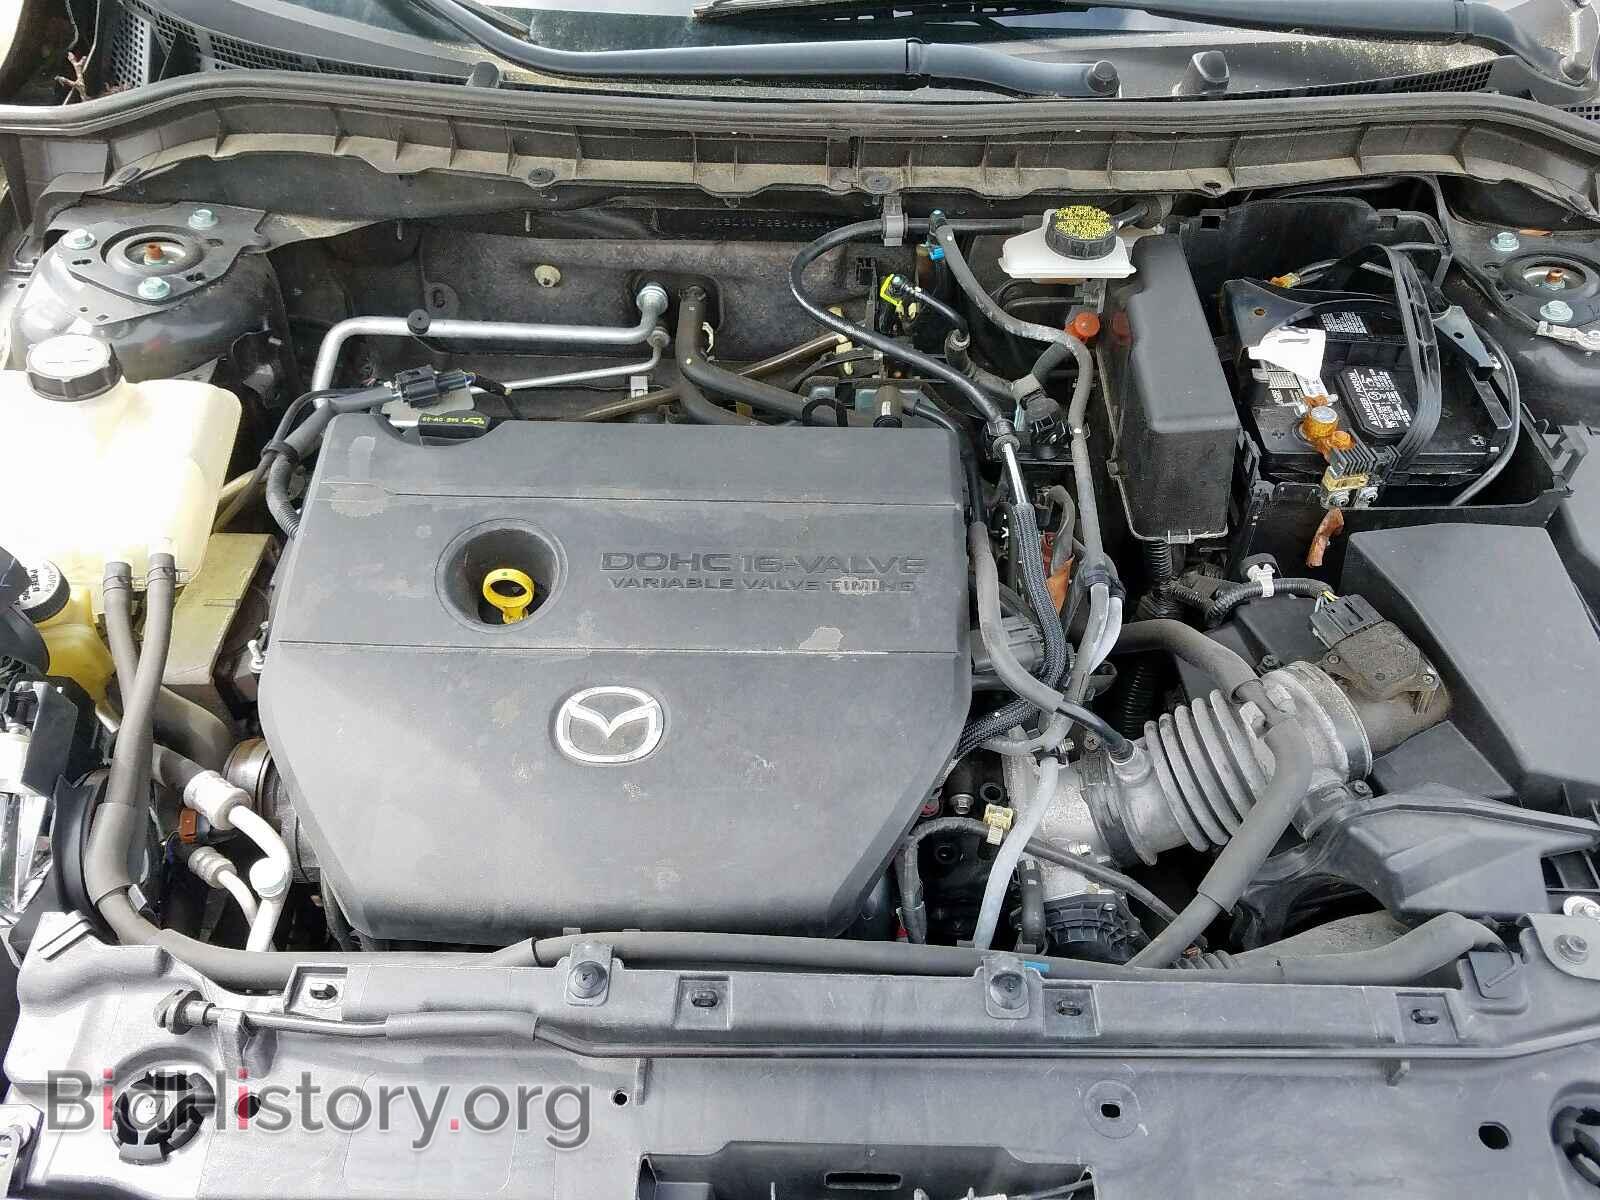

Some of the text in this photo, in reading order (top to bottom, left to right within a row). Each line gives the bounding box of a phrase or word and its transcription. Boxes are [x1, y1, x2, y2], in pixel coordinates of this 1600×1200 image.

[1360, 398, 1377, 421] DANGER
[600, 552, 928, 574] DOHC 16-VALVE
[609, 577, 734, 590] VARIABLE
[743, 578, 819, 591] VALVE
